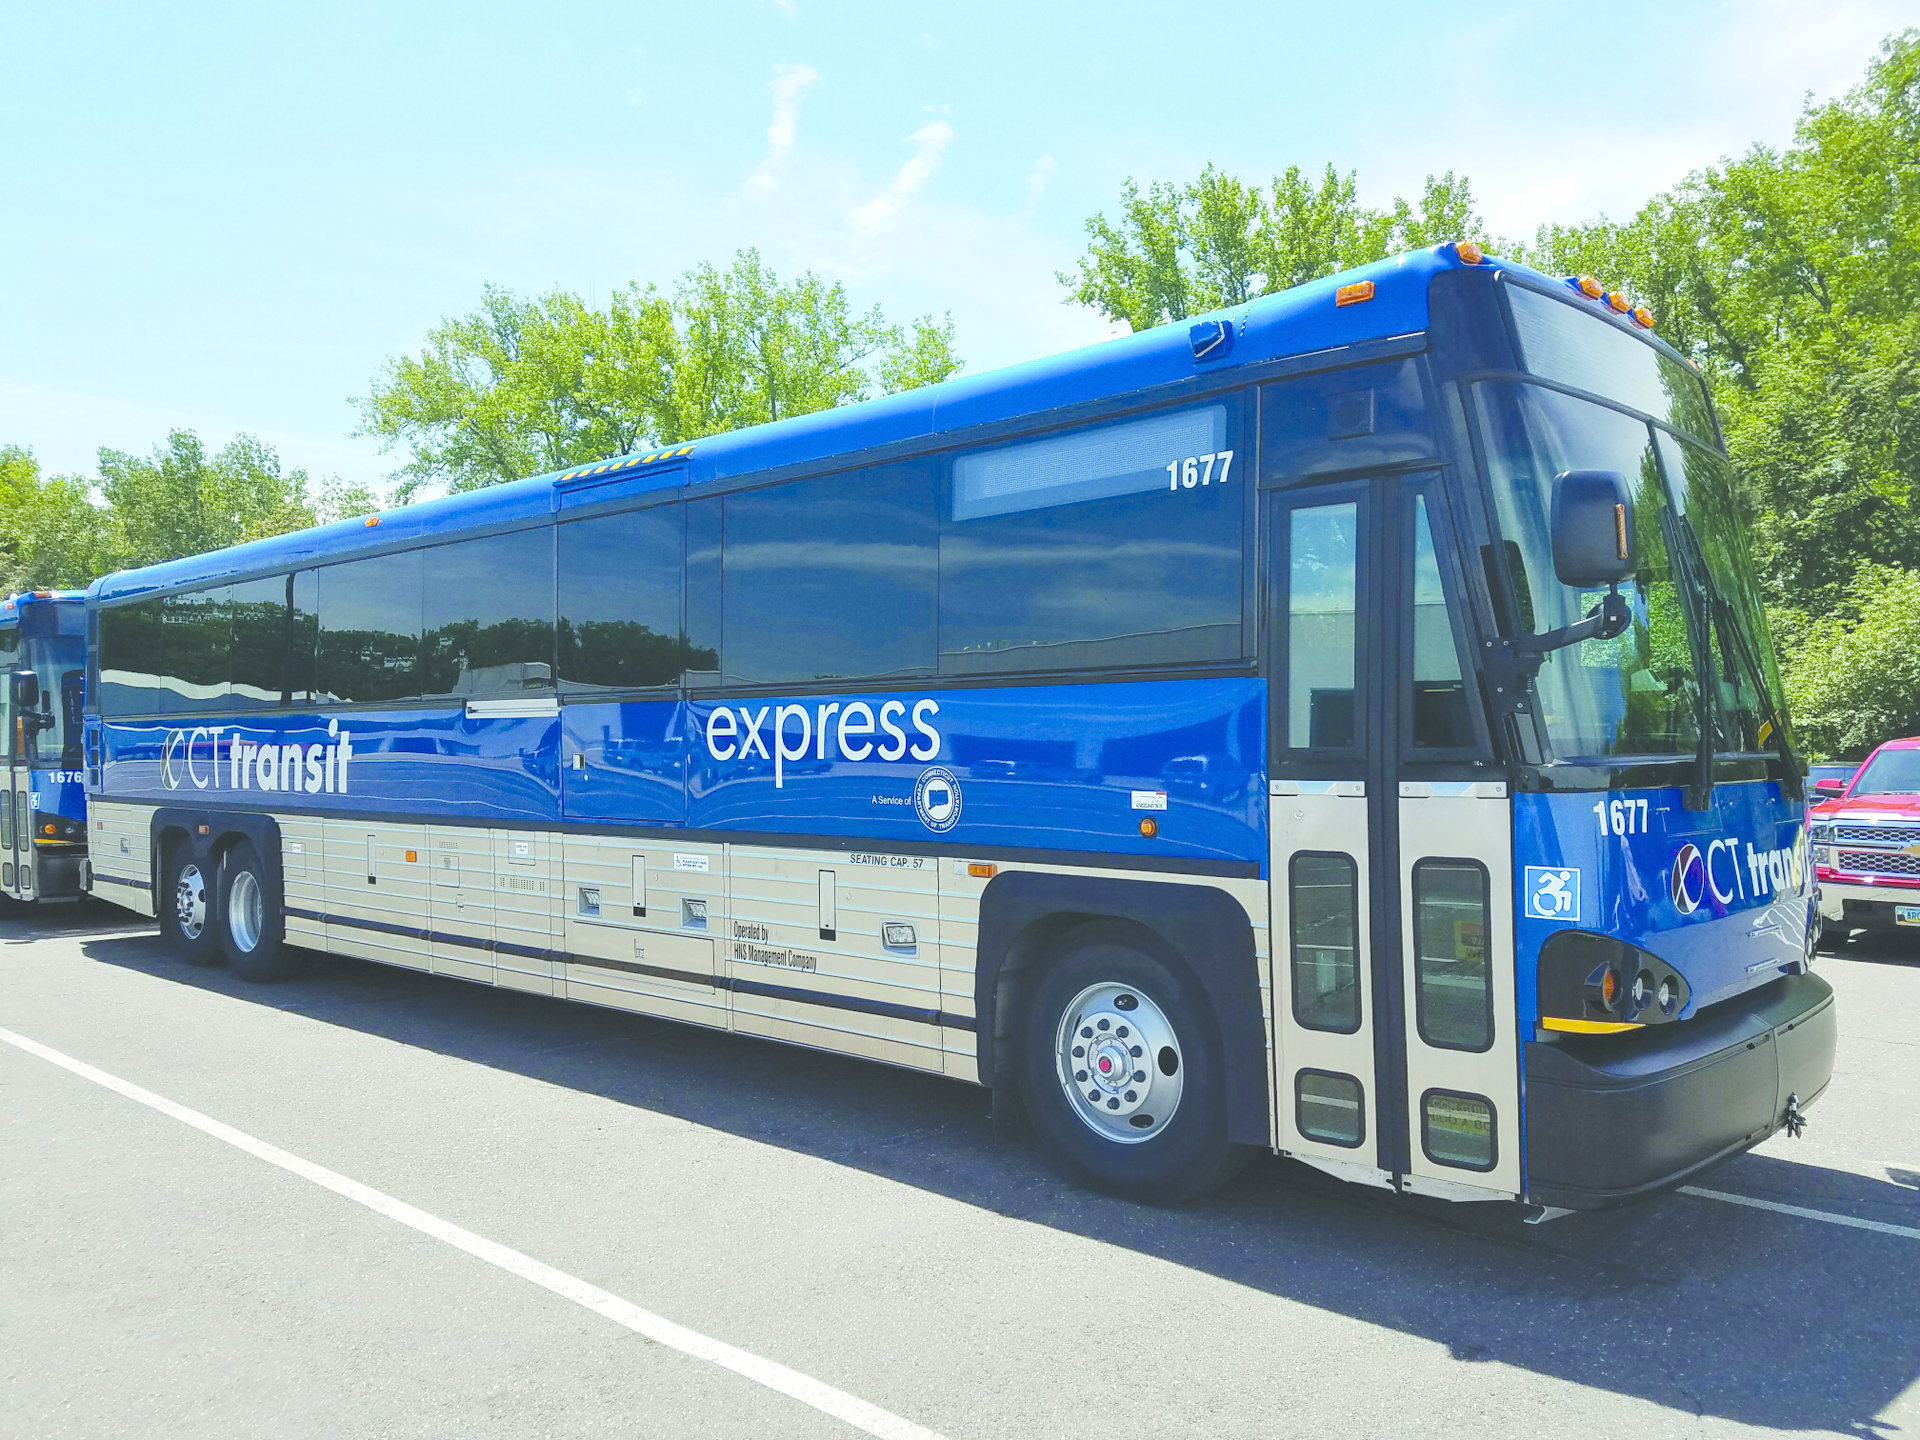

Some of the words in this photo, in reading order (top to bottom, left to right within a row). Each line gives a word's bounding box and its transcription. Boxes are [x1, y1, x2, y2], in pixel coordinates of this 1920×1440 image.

[1166, 450, 1234, 491] 1677
[188, 726, 224, 789] CT
[230, 717, 353, 794] transit
[706, 698, 941, 789] express
[48, 771, 82, 784] 1676
[922, 769, 954, 783] CONNECTICUT
[871, 795, 878, 805] A
[878, 795, 903, 806] Service
[904, 796, 912, 806] of
[1592, 798, 1648, 836] 1677
[849, 853, 888, 866] SEATING
[890, 857, 910, 868] CAP.
[912, 858, 924, 869] 57
[1707, 838, 1745, 904] CT
[734, 920, 760, 942] Operated
[761, 924, 769, 945] by
[734, 942, 747, 961] HNS
[748, 944, 787, 967] Management
[788, 949, 817, 974] Company
